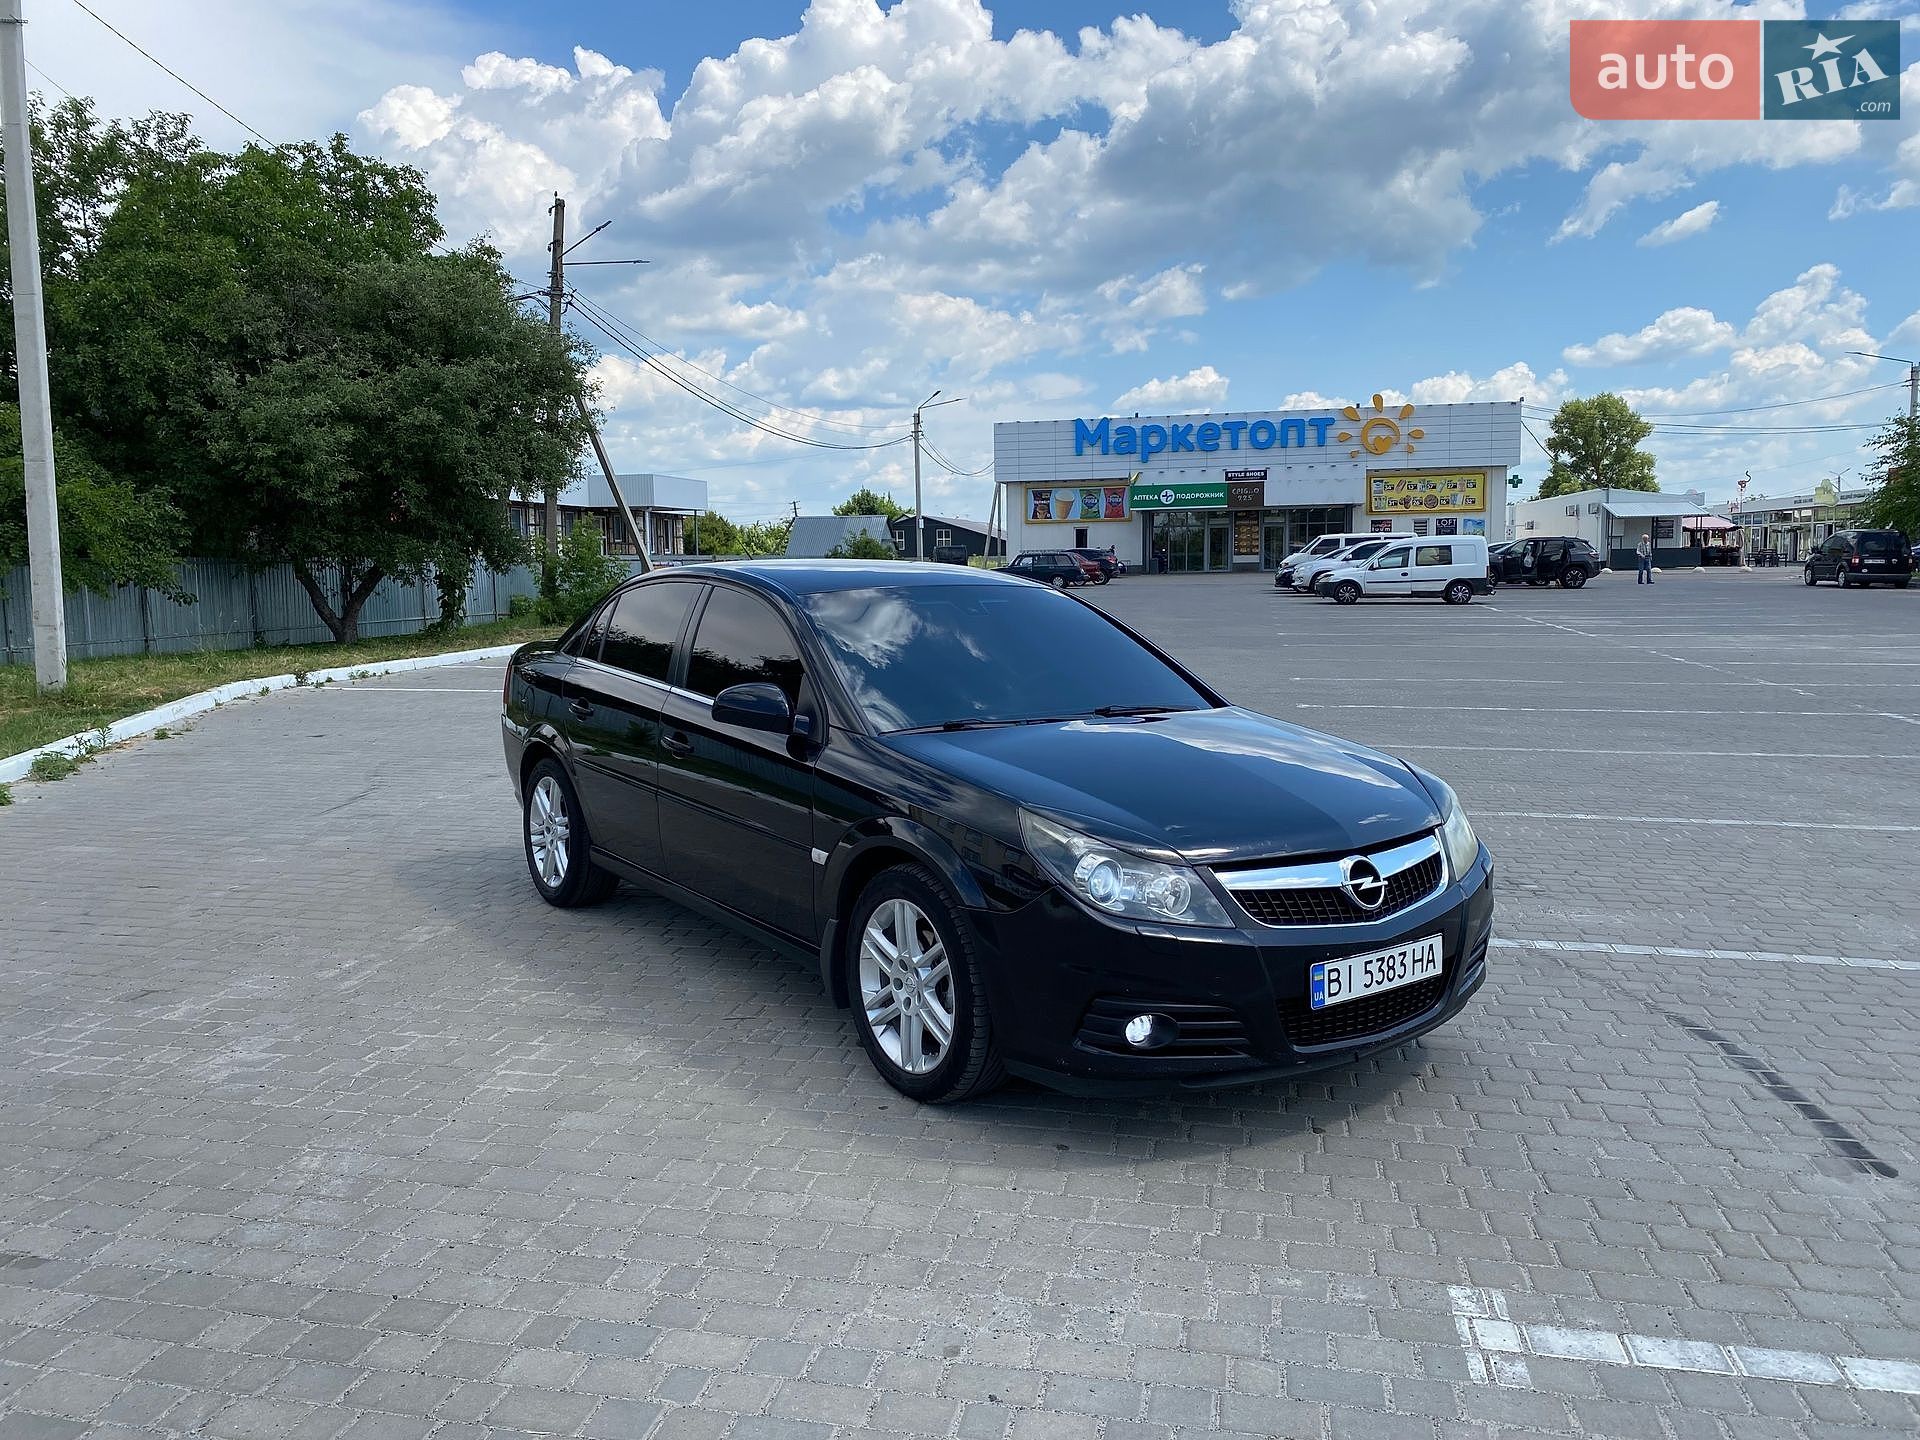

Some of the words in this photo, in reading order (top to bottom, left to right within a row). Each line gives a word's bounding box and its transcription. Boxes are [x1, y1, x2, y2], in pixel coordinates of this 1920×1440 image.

[1074, 417, 1336, 463] Маркетопт
[1176, 492, 1225, 500] ПОДОРОЖНИК
[1327, 965, 1352, 998] BI
[1363, 951, 1407, 988] 5383
[1412, 944, 1436, 976] HA
[1314, 991, 1324, 1001] UA
